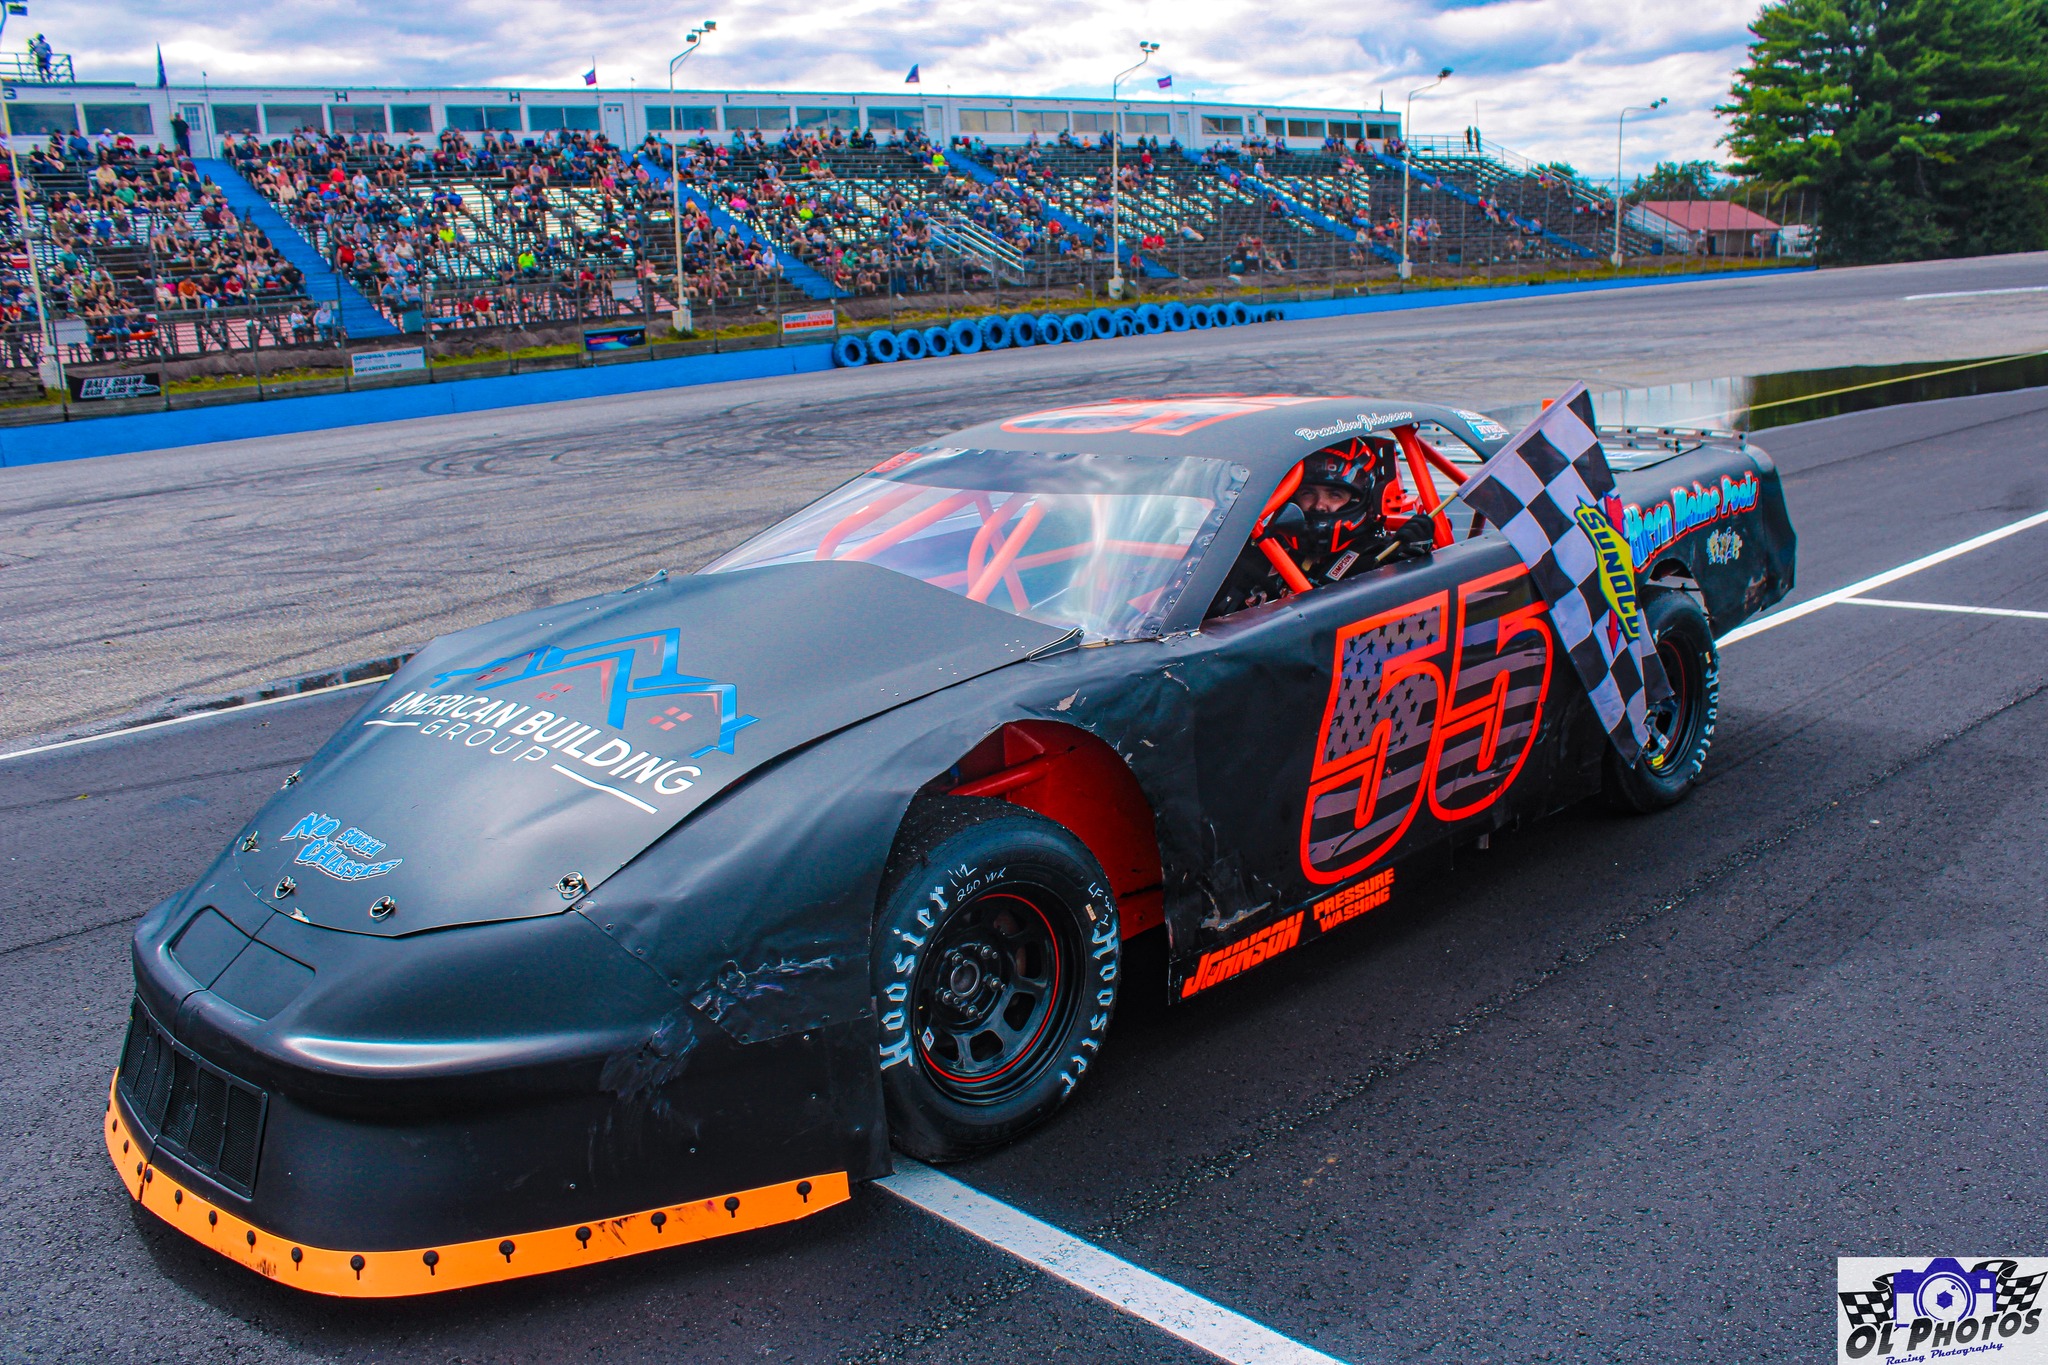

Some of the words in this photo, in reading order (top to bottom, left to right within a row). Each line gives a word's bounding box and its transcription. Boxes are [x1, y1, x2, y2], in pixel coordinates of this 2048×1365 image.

[335, 91, 348, 102] H
[509, 91, 521, 102] H
[1295, 419, 1362, 440] Brandon
[1356, 411, 1412, 431] Johnson
[1671, 486, 1721, 540] Maine
[1721, 471, 1759, 518] Pools
[1331, 554, 1353, 577] SIMPSON
[381, 690, 530, 727] AMERICAN
[510, 710, 703, 796] BUILDING
[419, 719, 550, 763] GROUP
[1300, 562, 1554, 885] 55
[280, 812, 341, 841] NO
[335, 826, 387, 860] SUCH
[294, 838, 403, 882] CHASSIS
[1313, 867, 1395, 921] PRESSURE
[1319, 886, 1391, 933] WASHING
[1181, 910, 1305, 999] JOHNSON
[878, 885, 949, 1071] Hoosier
